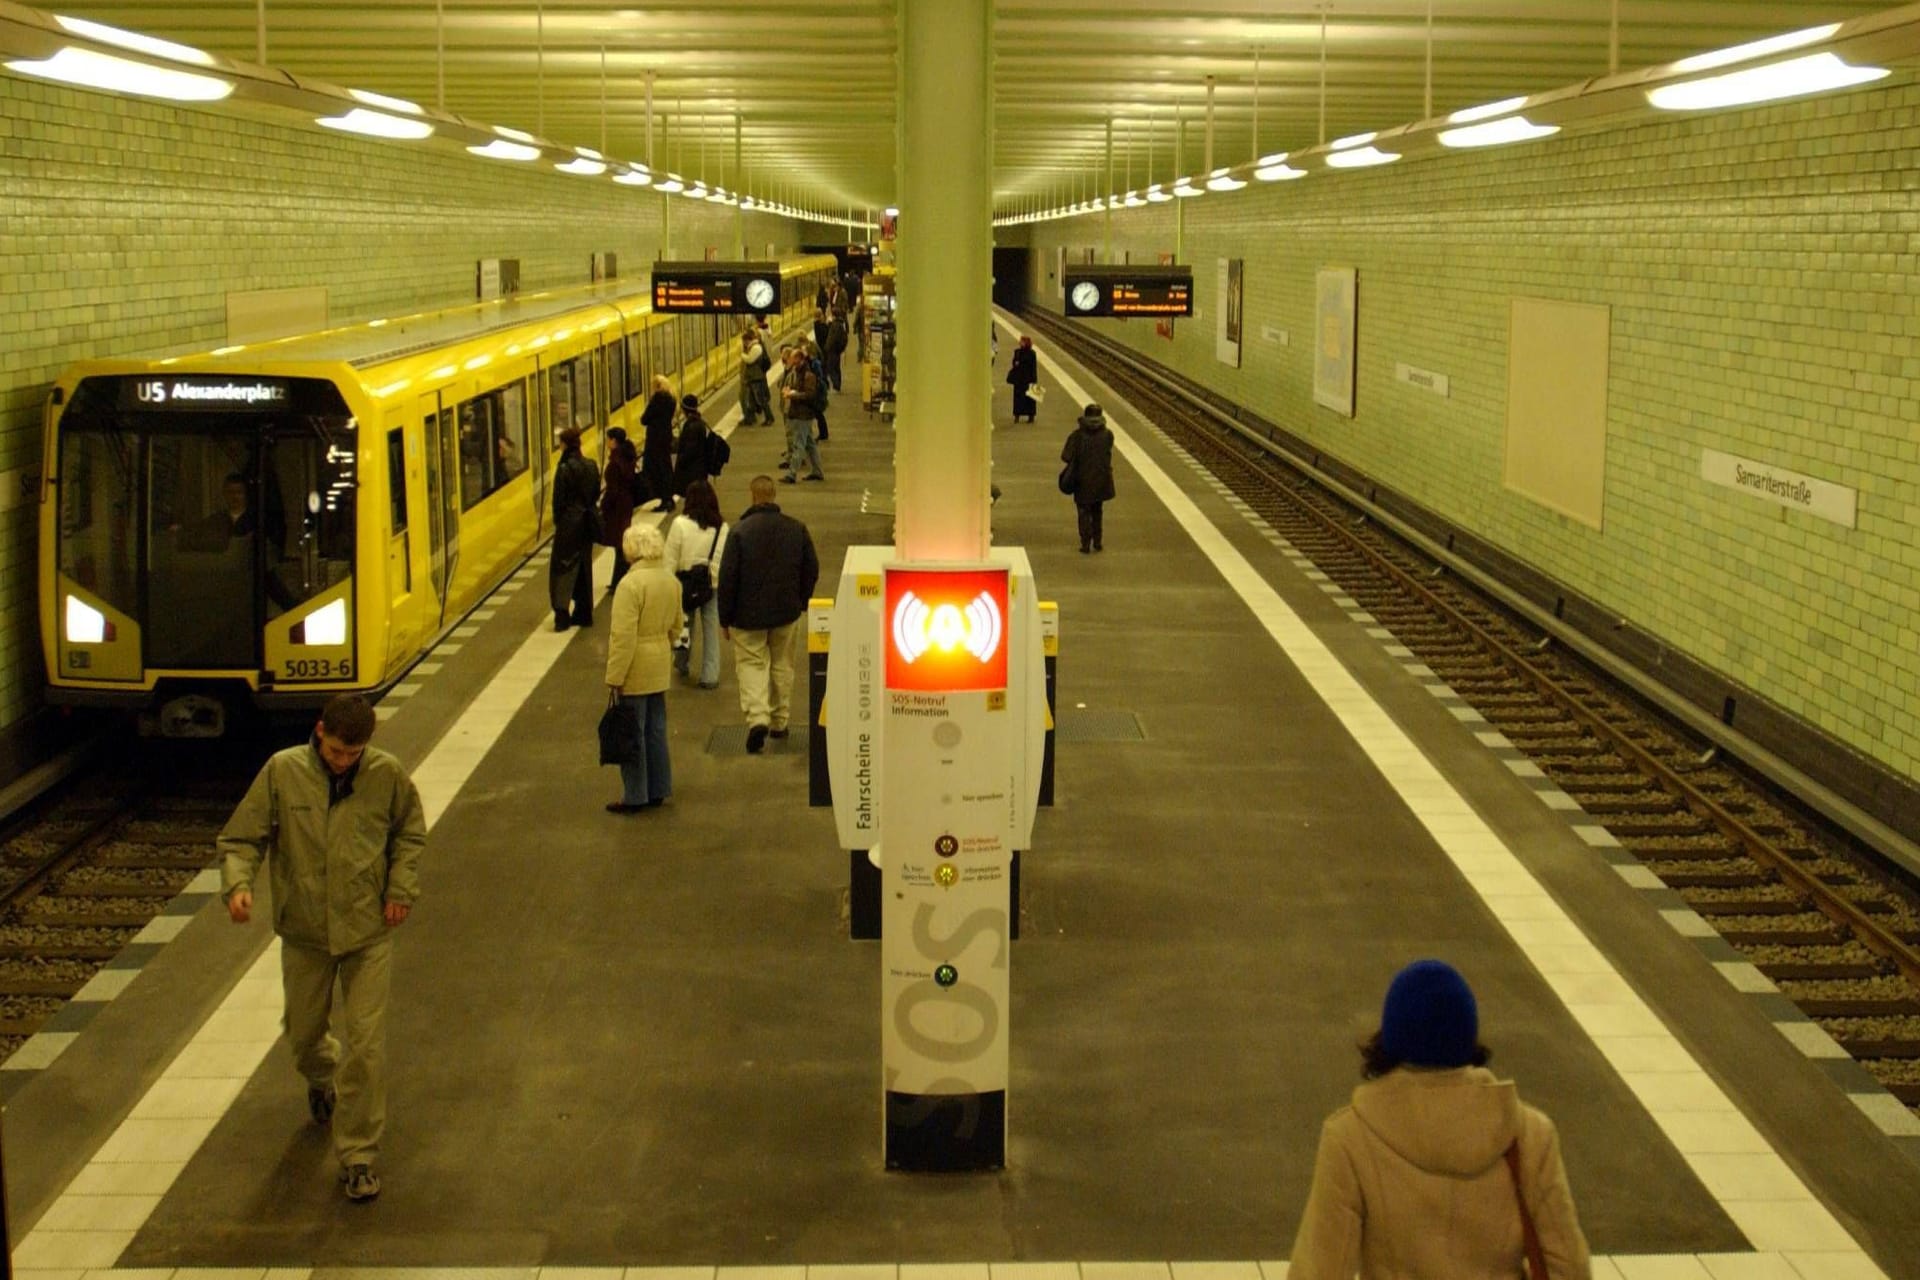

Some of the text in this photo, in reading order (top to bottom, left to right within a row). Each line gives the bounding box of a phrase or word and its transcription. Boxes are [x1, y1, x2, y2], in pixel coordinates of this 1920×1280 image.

[138, 382, 285, 403] U5 Alexanderplatz
[1735, 463, 1811, 505] Samariterstraße
[860, 585, 878, 596] BVG
[285, 658, 350, 678] 5033-6
[892, 694, 945, 707] SOS-Notruf
[891, 705, 949, 718] Information
[856, 733, 872, 830] Fahrscheine
